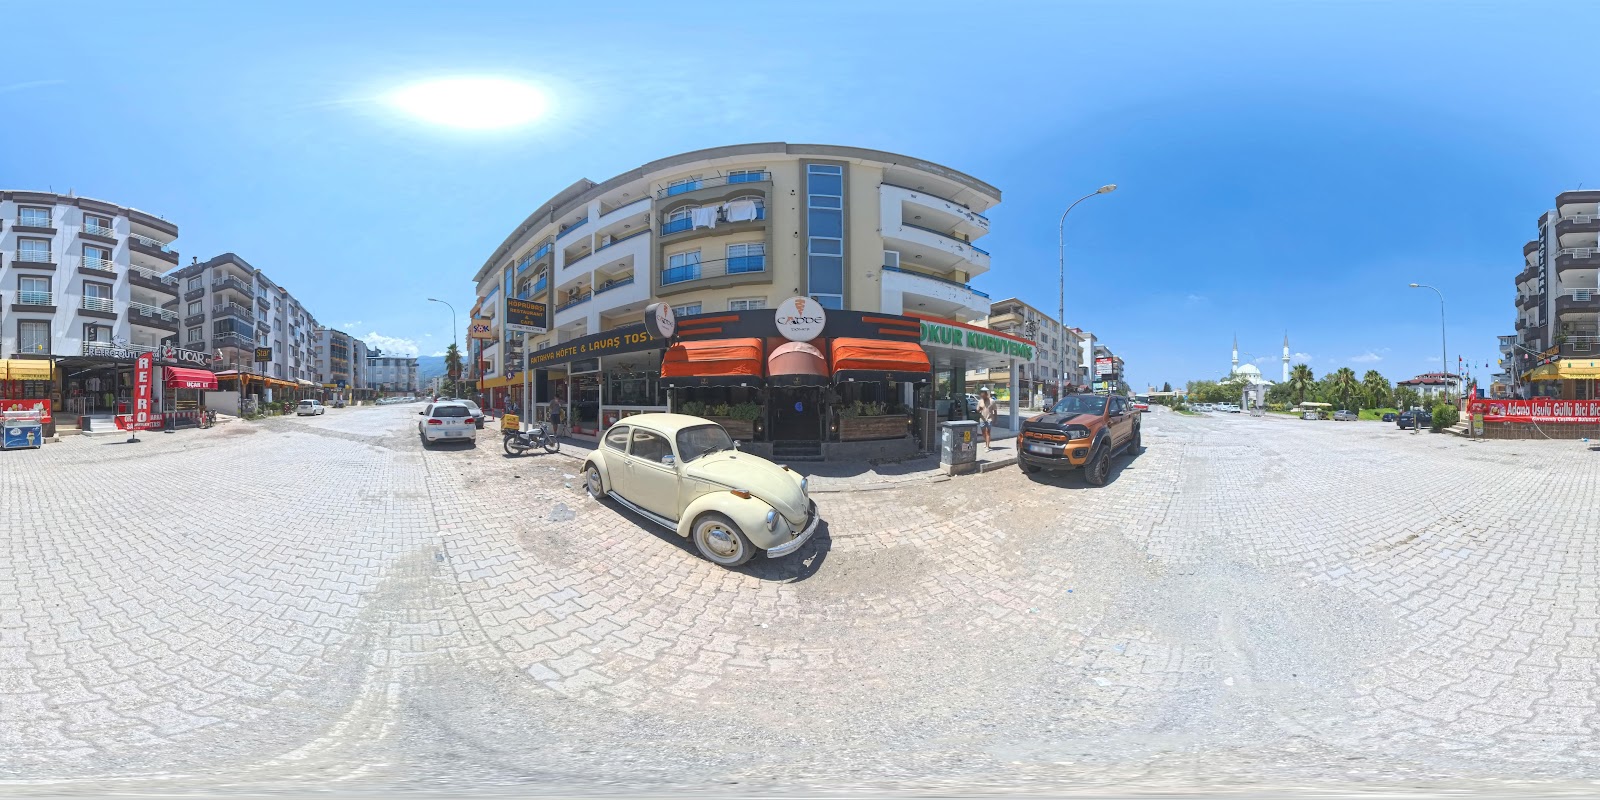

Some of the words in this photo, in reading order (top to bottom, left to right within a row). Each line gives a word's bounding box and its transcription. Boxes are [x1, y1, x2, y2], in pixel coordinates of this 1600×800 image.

[777, 316, 823, 325] CADDE
[530, 353, 554, 365] ANTAKYA
[556, 345, 577, 358] KÖFTE
[580, 344, 587, 353] &
[589, 335, 620, 350] LAVAŞ
[137, 357, 149, 423] RETRO
[1507, 402, 1530, 416] Adana
[1532, 402, 1551, 416] Usulü
[1575, 402, 1588, 416] Bici
[1589, 402, 1600, 416] Bic
